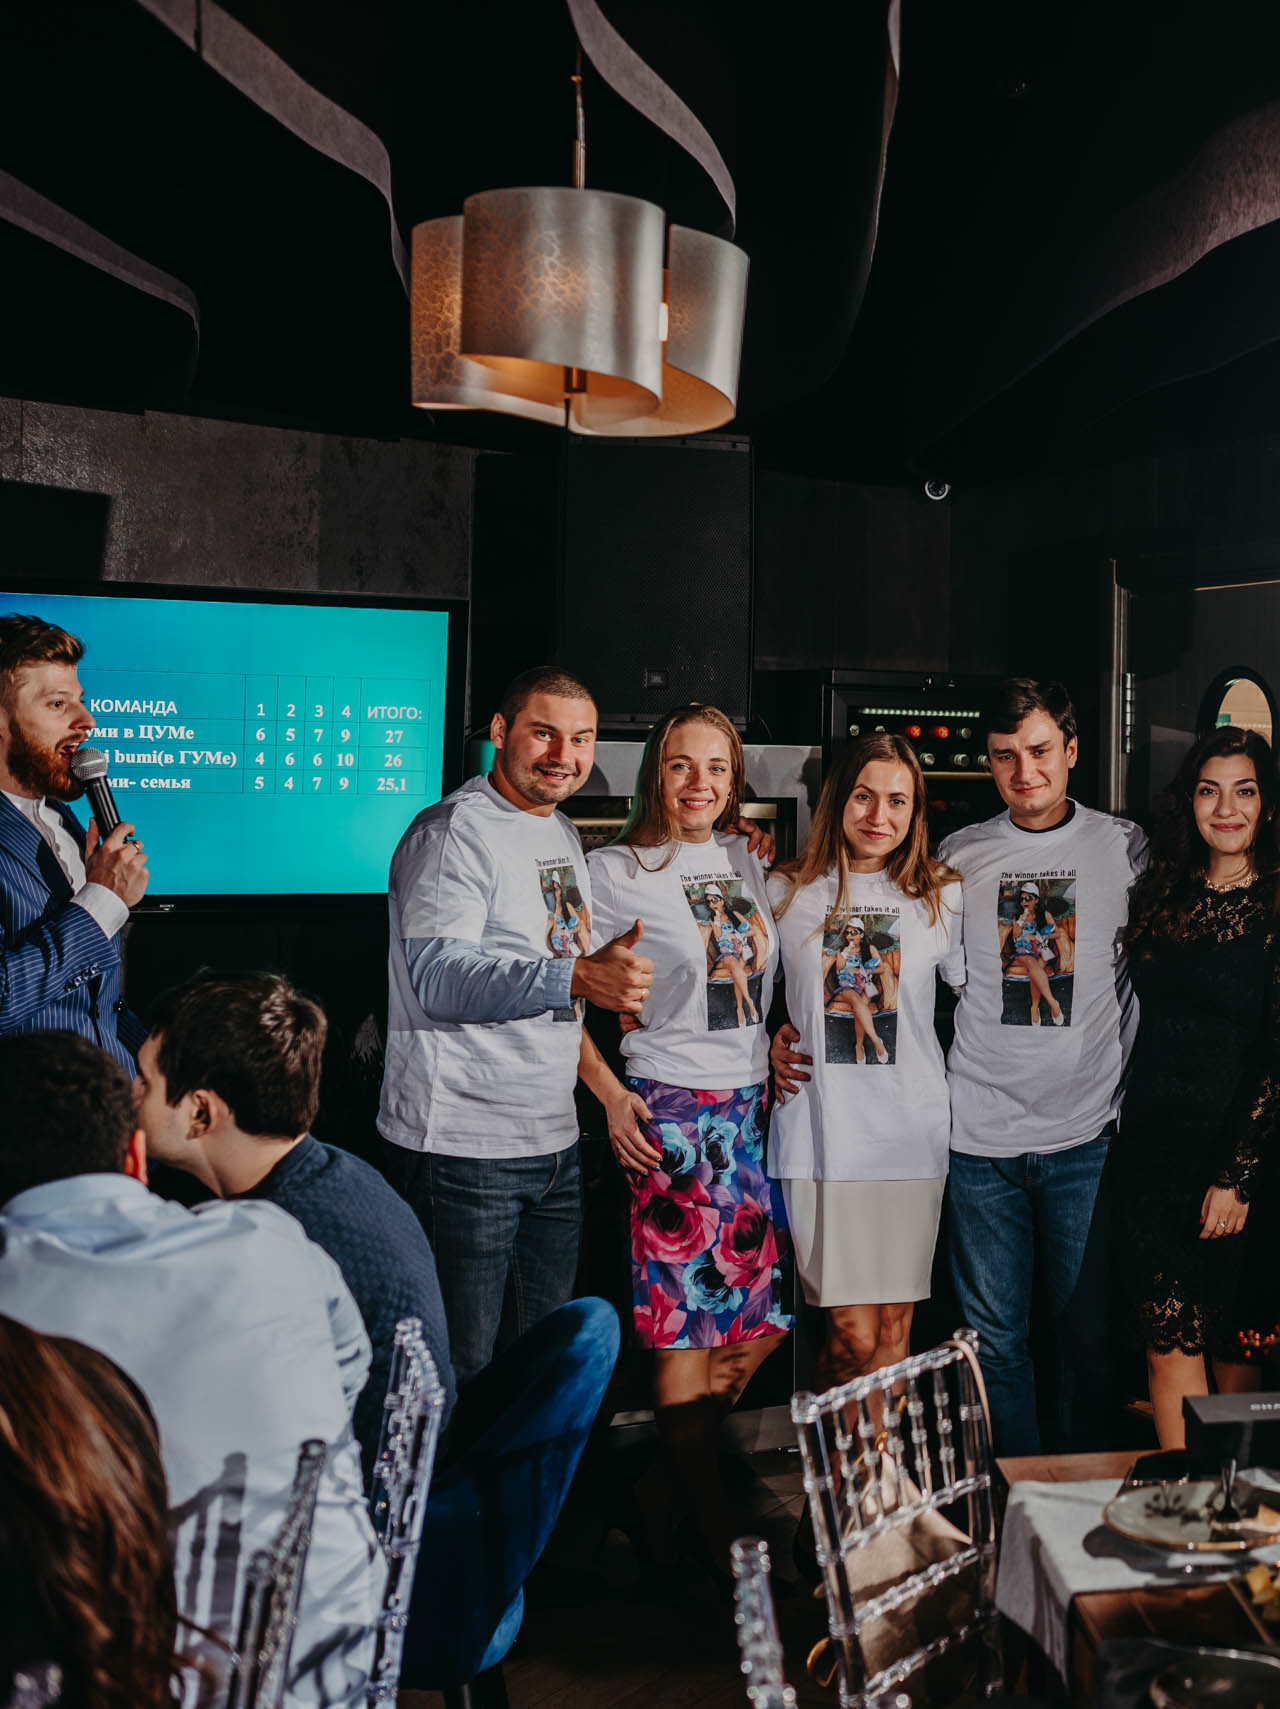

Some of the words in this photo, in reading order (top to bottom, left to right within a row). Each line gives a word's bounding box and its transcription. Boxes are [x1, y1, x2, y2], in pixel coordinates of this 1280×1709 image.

[90, 698, 178, 716] КОМАНДА
[256, 703, 266, 717] 1
[286, 703, 296, 718] 2
[313, 704, 324, 718] 3
[341, 705, 351, 719] 4
[367, 705, 423, 720] ИТОГО:
[138, 724, 195, 742] ЦУМе
[255, 727, 266, 742] 6
[285, 727, 296, 742] 5
[313, 728, 323, 743] 7
[340, 729, 351, 743] 9
[384, 730, 404, 744] 27
[178, 750, 237, 768] ГУМе)
[254, 752, 265, 766] 4
[284, 752, 295, 766] 6
[312, 753, 323, 767] 6
[336, 753, 354, 767] 10
[384, 754, 403, 768] 26
[140, 778, 191, 789] семья
[253, 776, 265, 790] 5
[283, 777, 294, 791] 4
[311, 777, 322, 791] 7
[338, 777, 350, 791] 9
[376, 778, 406, 793] 25,1
[680, 874, 692, 883] The
[693, 872, 715, 881] winner
[1015, 871, 1038, 879] winner
[1039, 869, 1059, 877] takes
[1060, 868, 1066, 876] it
[1067, 868, 1078, 877] all
[884, 905, 890, 913] it
[891, 906, 900, 914] all
